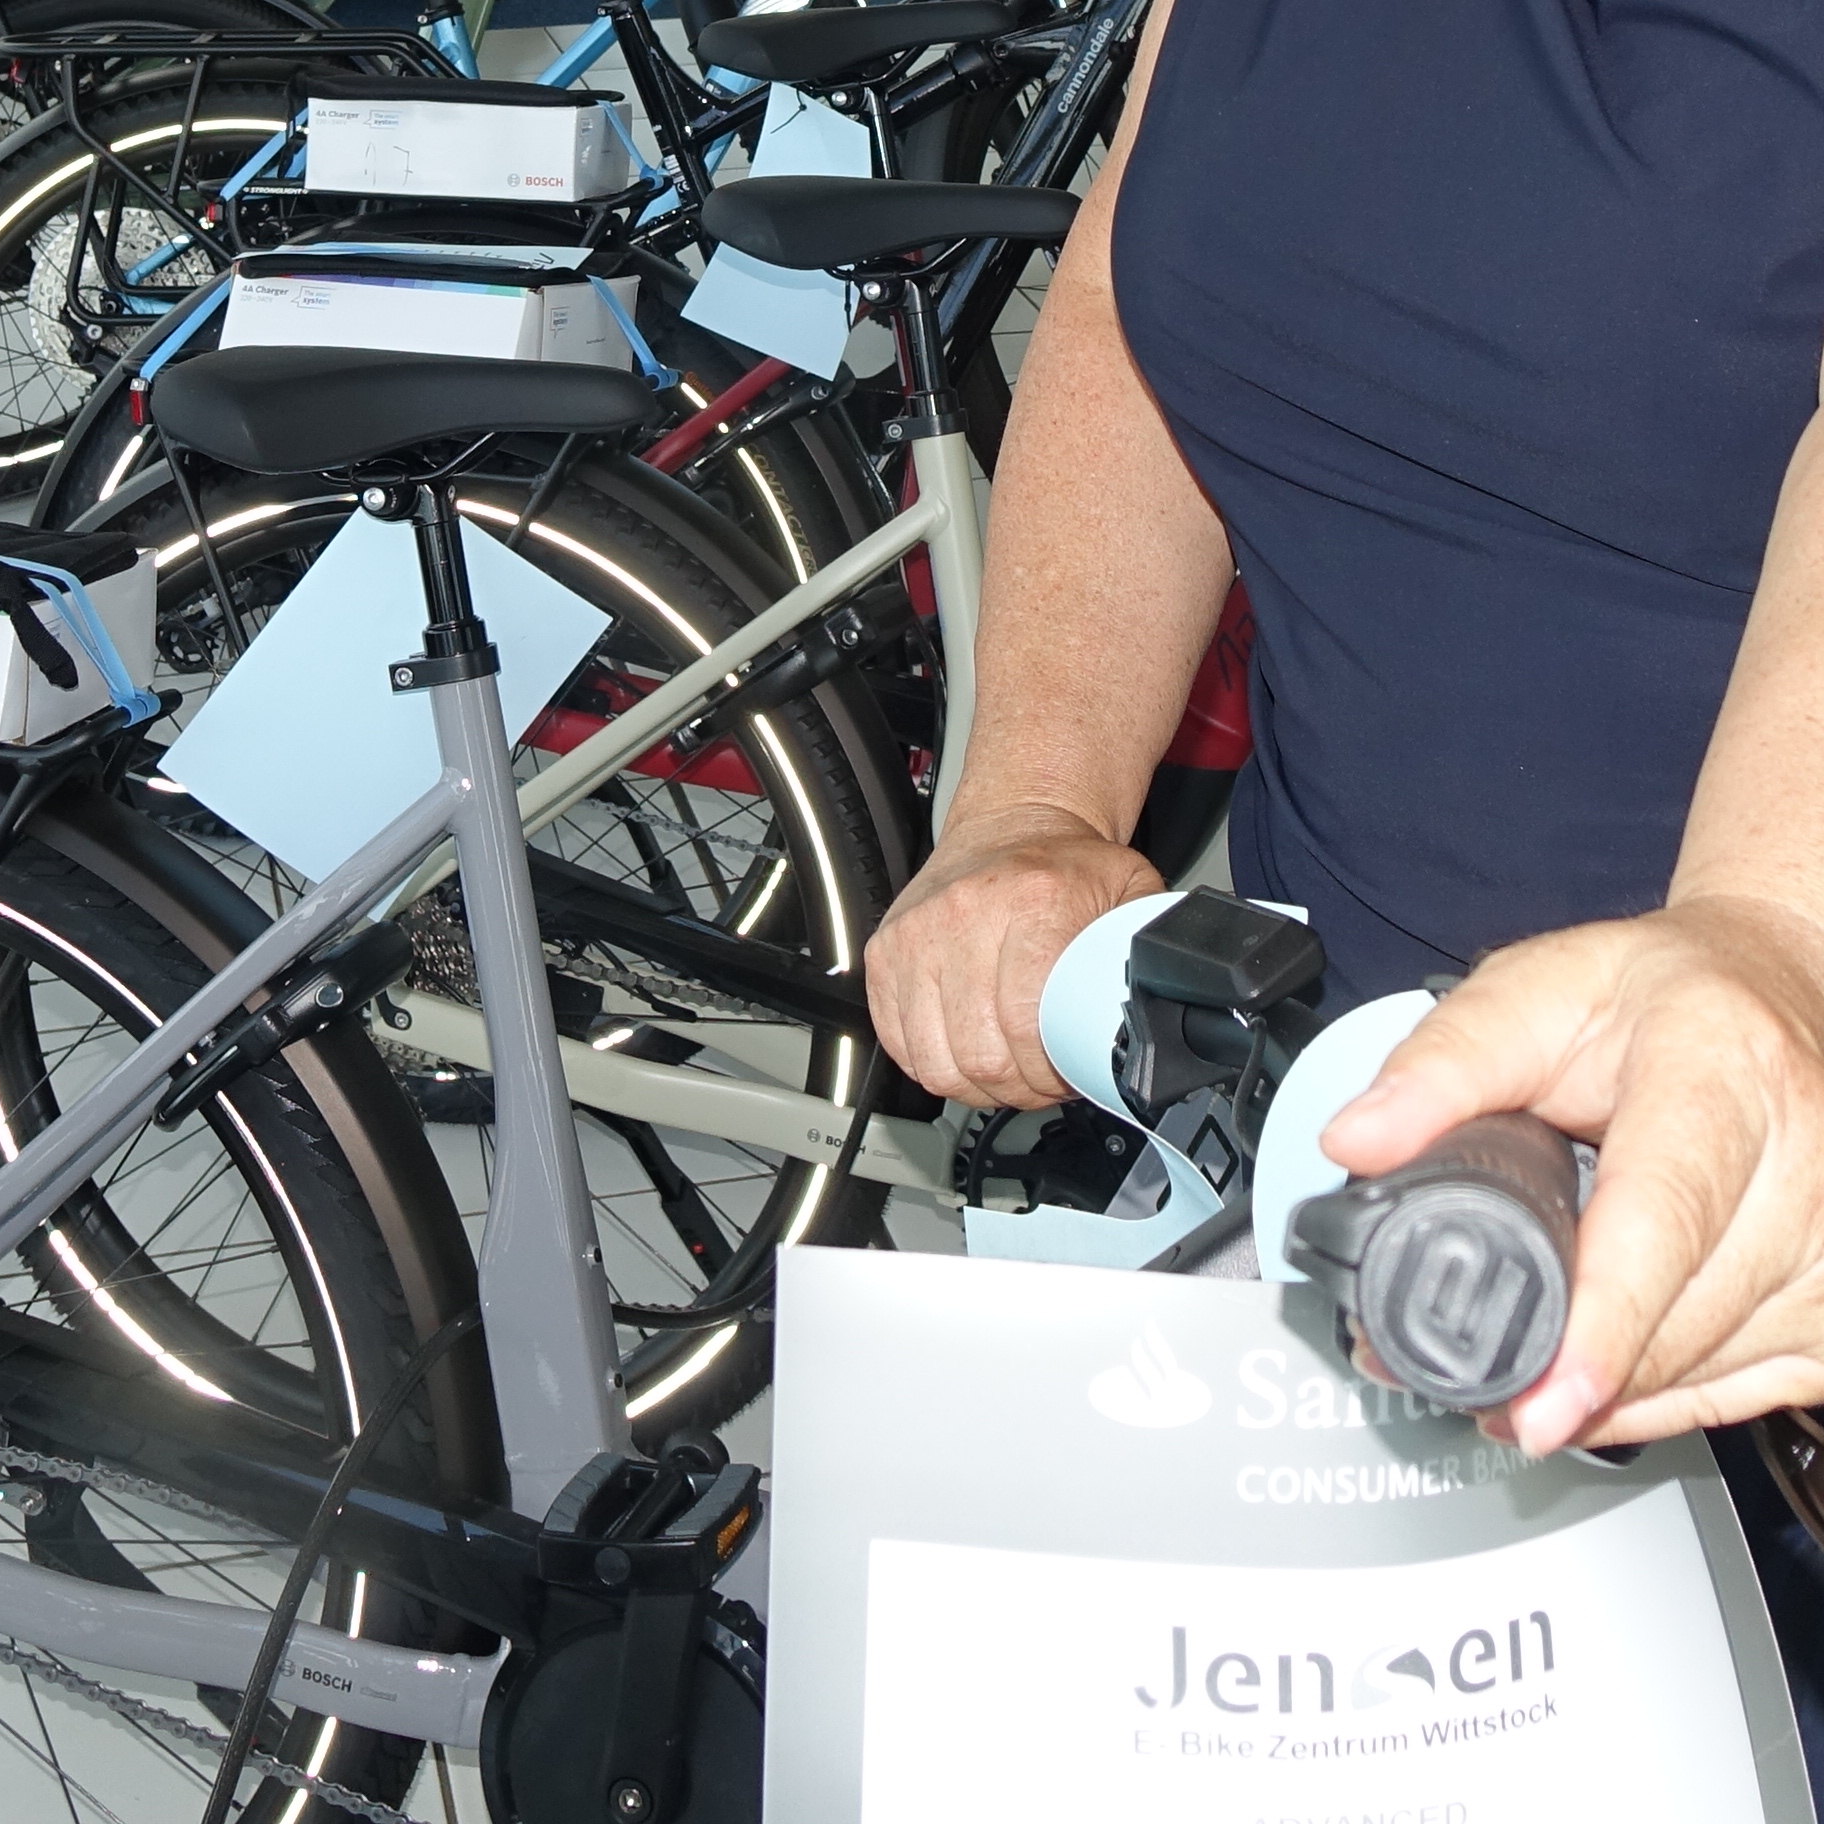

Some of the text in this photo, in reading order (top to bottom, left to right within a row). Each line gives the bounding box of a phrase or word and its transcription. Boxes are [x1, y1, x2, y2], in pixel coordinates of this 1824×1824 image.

[1057, 17, 1115, 114] cannondale
[315, 109, 360, 122] 4A Charger
[373, 119, 399, 128] system
[525, 176, 564, 188] BOSCH
[242, 283, 289, 298] 4A Charger
[302, 297, 330, 307] system
[825, 1135, 866, 1154] BOH
[1236, 1462, 1464, 1505] CONSUMER
[301, 1667, 353, 1693] BOSCH
[1180, 1730, 1255, 1758] Bike
[1268, 1731, 1409, 1761] Zentrum
[1421, 1693, 1559, 1748] Wittstock
[1252, 1801, 1468, 1824] ANCED
